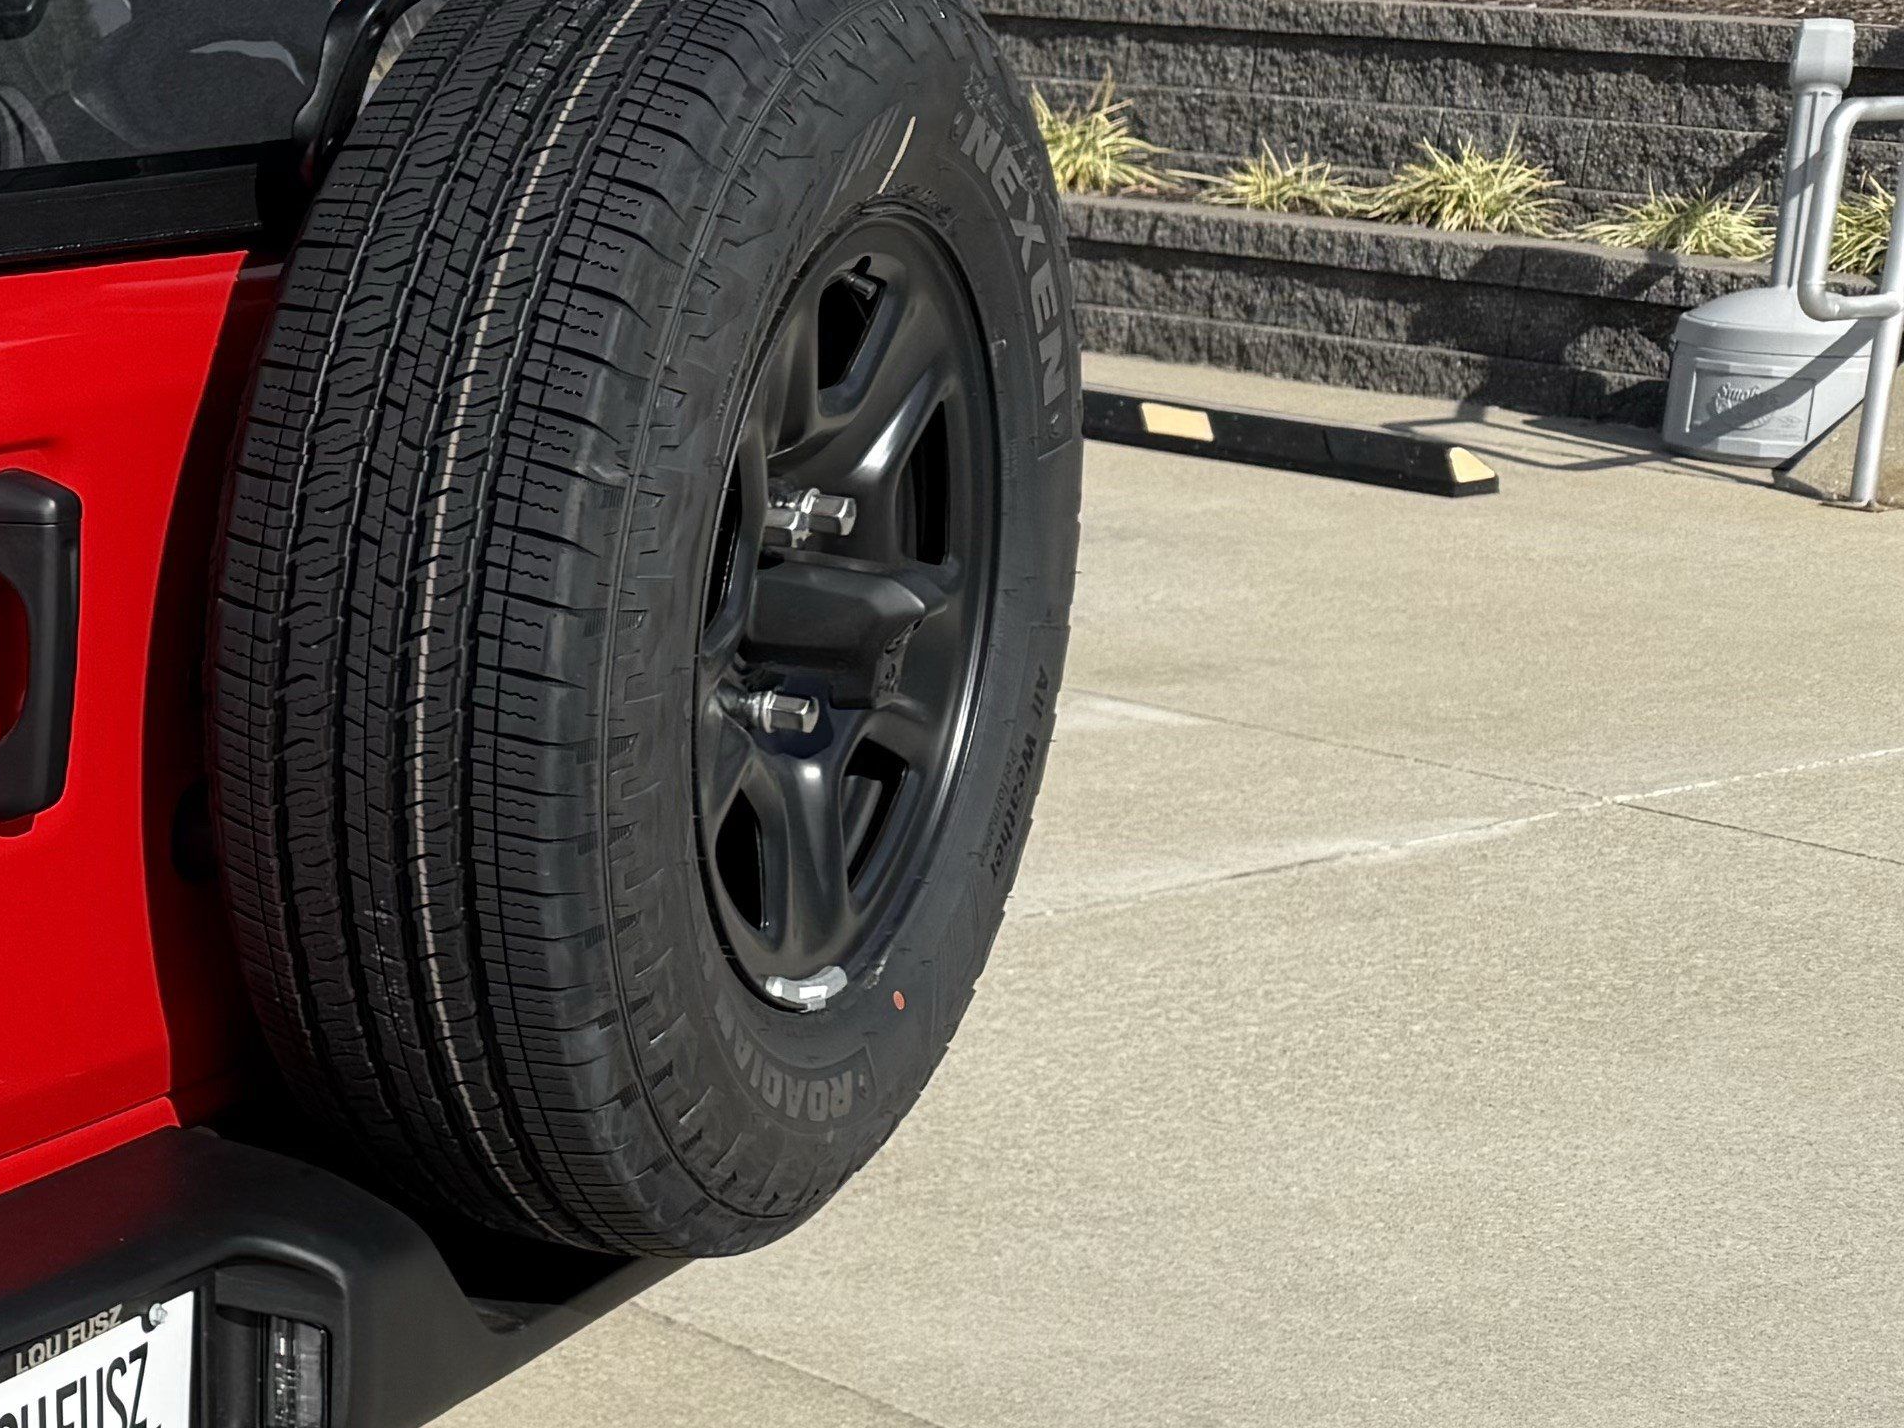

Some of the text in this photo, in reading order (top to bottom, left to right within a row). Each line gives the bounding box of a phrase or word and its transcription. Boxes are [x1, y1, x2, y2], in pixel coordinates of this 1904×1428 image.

[959, 113, 1067, 409] NEXEN
[15, 1303, 124, 1375] LOU FUSZ
